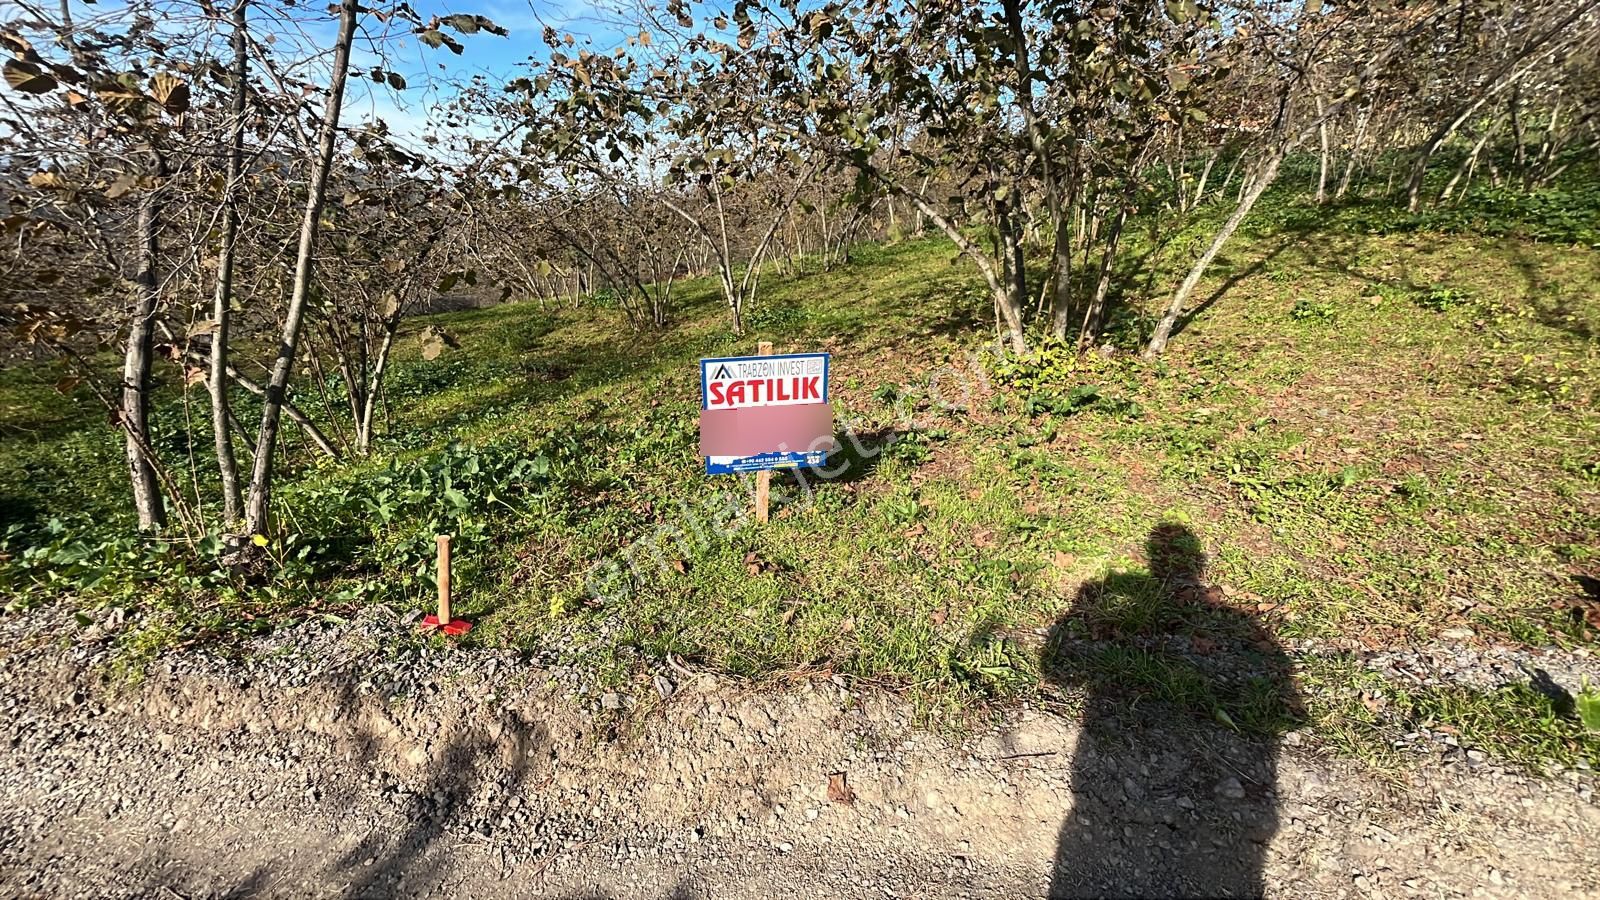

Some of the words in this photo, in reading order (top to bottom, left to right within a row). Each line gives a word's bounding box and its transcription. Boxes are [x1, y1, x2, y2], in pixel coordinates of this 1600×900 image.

[738, 362, 775, 379] TRABZON
[777, 360, 805, 377] INVEST
[709, 376, 820, 406] SATILIK
